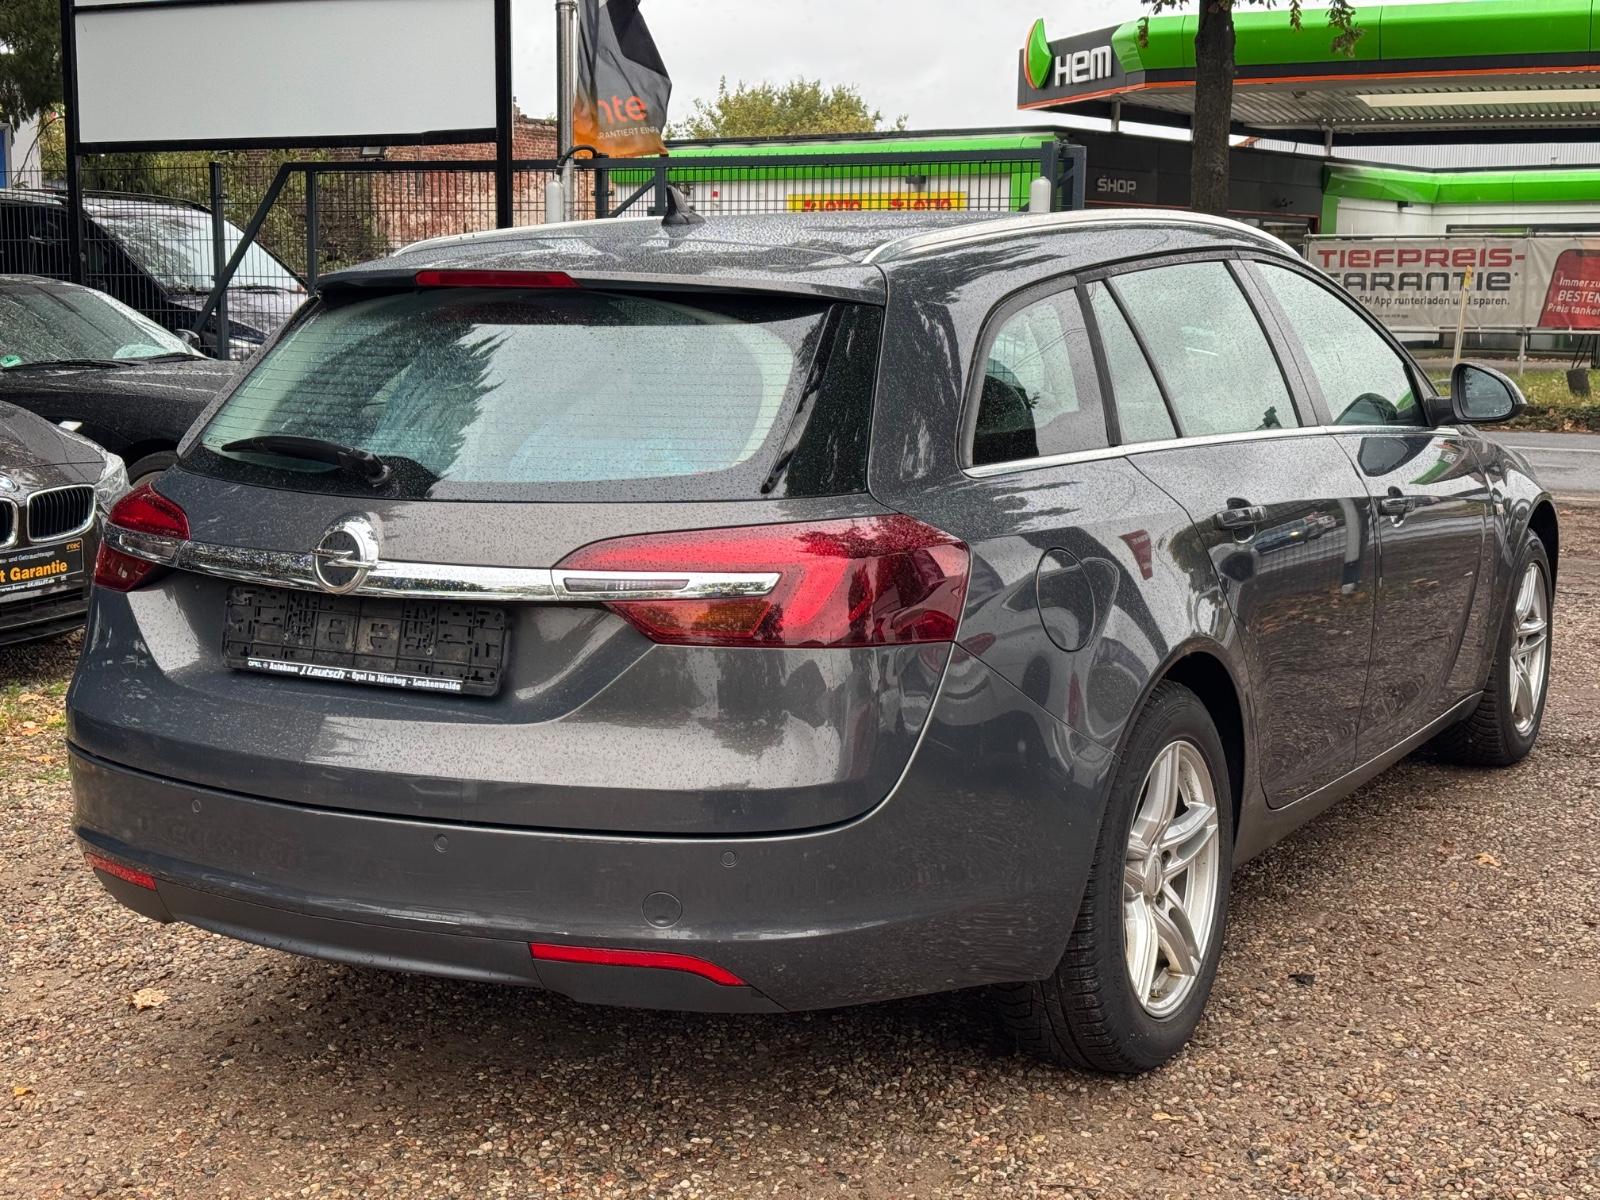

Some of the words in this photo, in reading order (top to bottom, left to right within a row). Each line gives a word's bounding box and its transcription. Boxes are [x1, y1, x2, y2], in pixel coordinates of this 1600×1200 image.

[1054, 45, 1112, 87] HEM
[597, 95, 648, 125] nte
[597, 127, 639, 139] RANTIERT
[1097, 177, 1136, 193] SHOP
[1317, 248, 1526, 268] TIEFPREIS-
[1560, 277, 1589, 287] Immer
[1374, 296, 1392, 308] App
[1394, 296, 1450, 305] runterladen
[1452, 296, 1471, 305] ud
[1473, 297, 1510, 308] sparen.
[1547, 303, 1570, 313] Preis
[10, 560, 68, 581] Garantie
